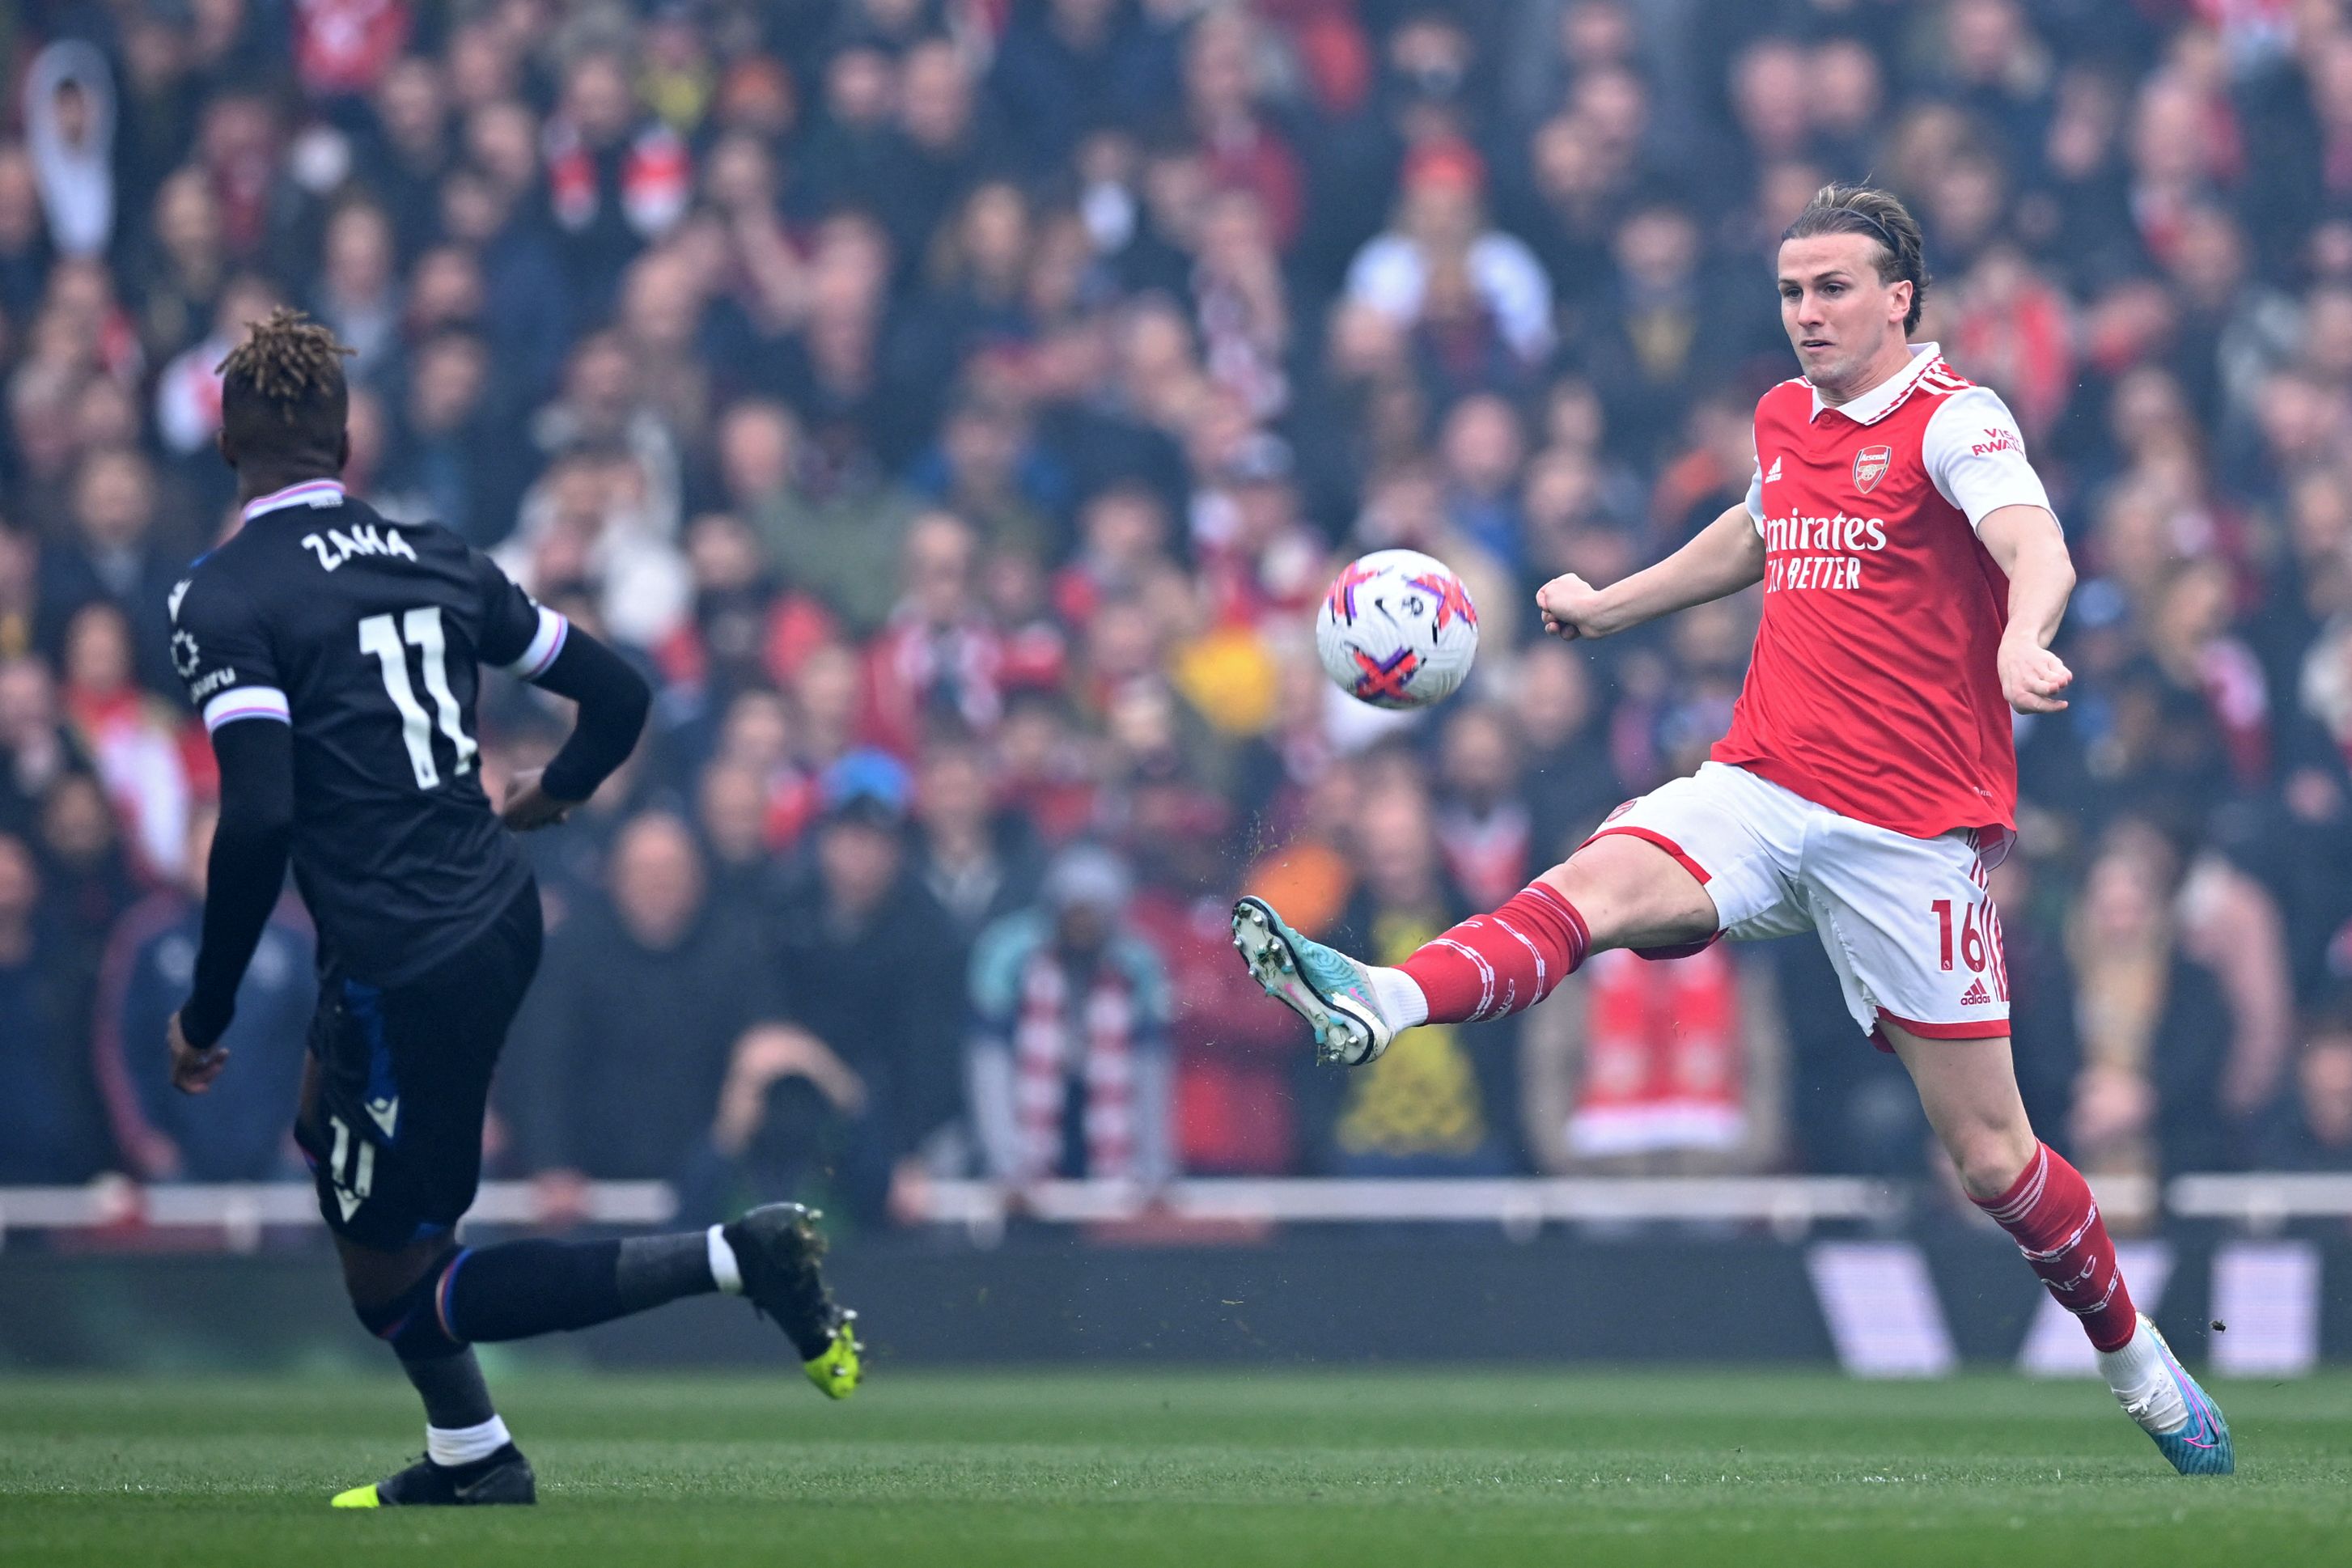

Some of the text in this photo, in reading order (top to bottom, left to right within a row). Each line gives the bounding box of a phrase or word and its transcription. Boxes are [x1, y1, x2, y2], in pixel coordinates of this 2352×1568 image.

[1859, 451, 1887, 462] Arsenal
[1972, 439, 2025, 459] RWA
[1984, 429, 2020, 447] VIS
[301, 523, 418, 572] ZAHA
[1763, 507, 1887, 553] mirates
[1787, 556, 1861, 591] BETTER
[358, 606, 477, 790] 11
[1930, 899, 1986, 973] 16
[1960, 994, 1990, 1006] adidas
[329, 1114, 376, 1198] 11
